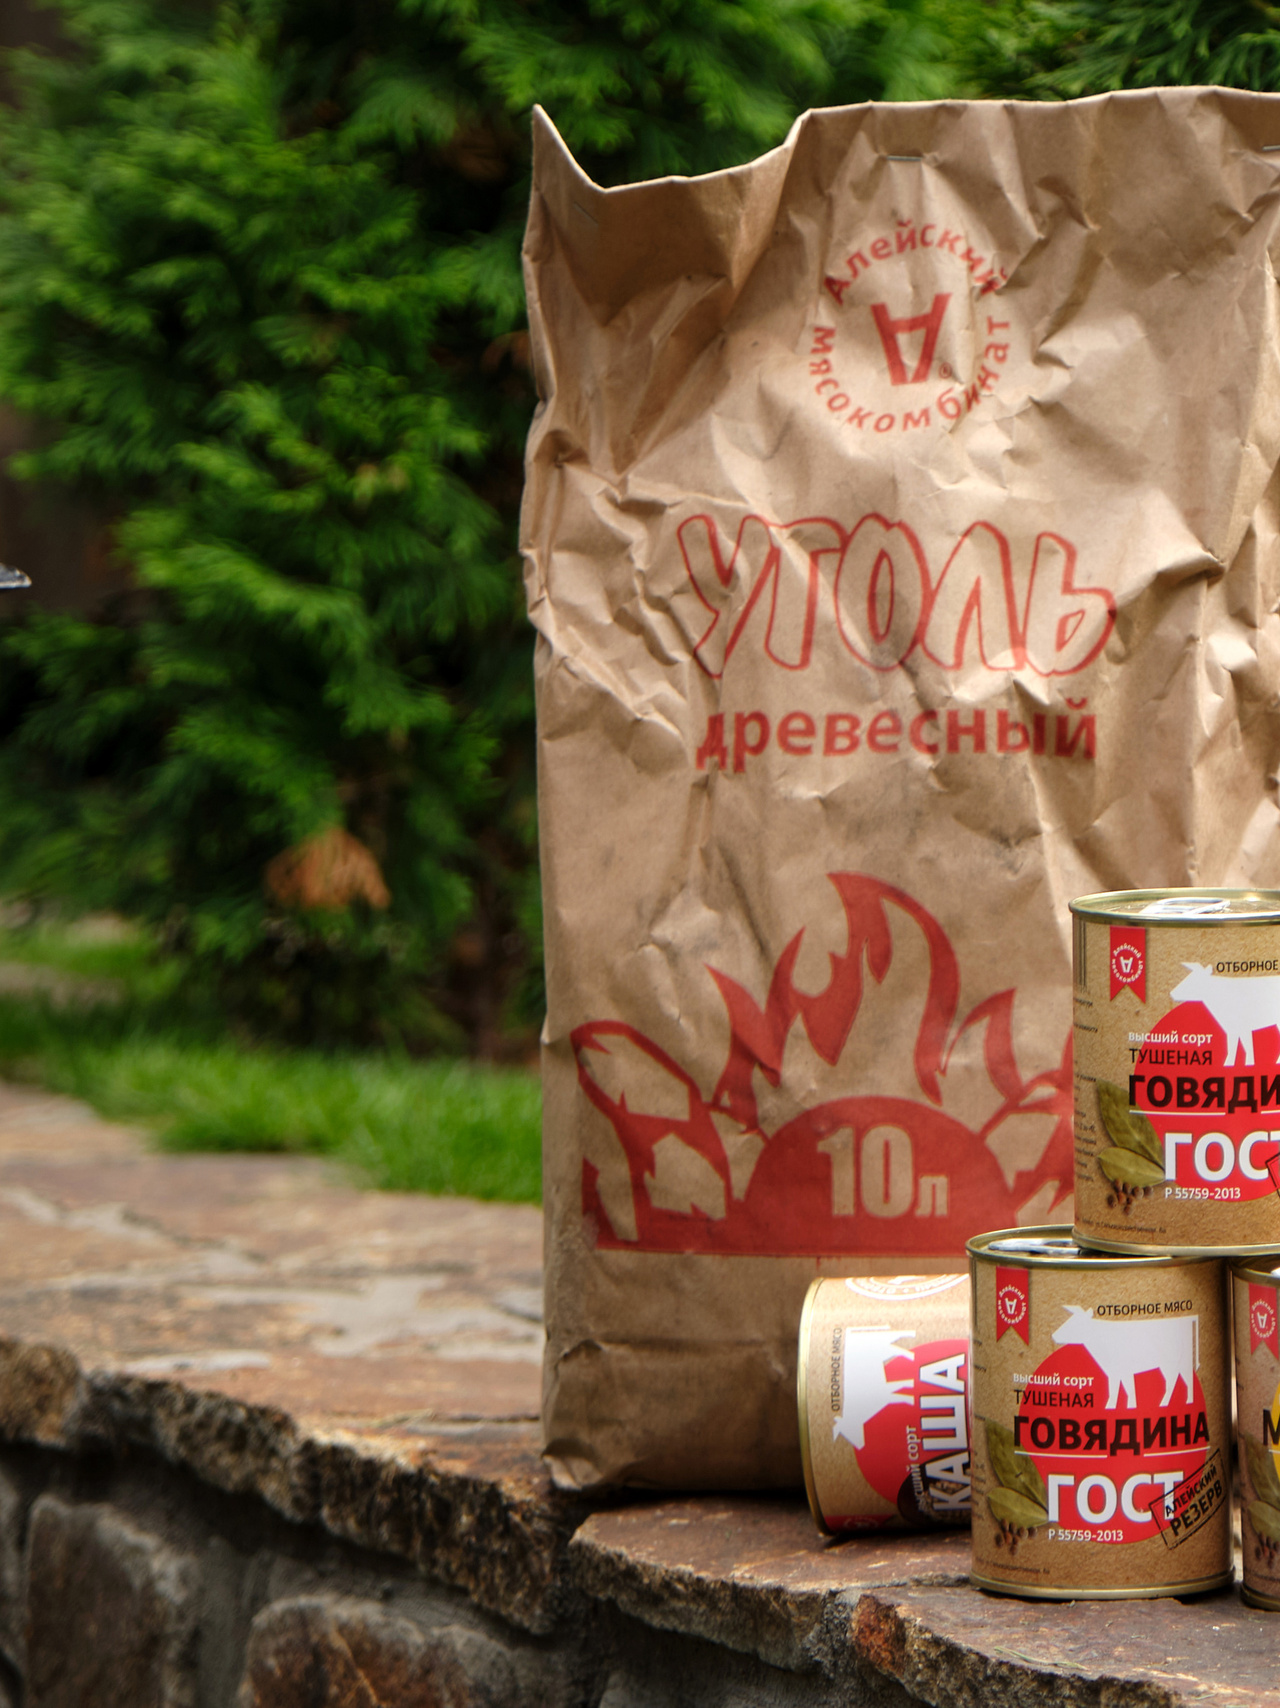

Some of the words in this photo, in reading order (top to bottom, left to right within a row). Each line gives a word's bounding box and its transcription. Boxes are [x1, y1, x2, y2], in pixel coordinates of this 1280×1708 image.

[824, 218, 1008, 306] Алейский
[809, 316, 1010, 434] мясокомбинат
[677, 512, 1117, 679] УГОЛЬ
[695, 698, 1098, 773] древесный
[1216, 959, 1279, 973] ОТБОРНОЕ
[1128, 1030, 1179, 1044] высший
[1181, 1033, 1213, 1046] сорт
[1128, 1048, 1213, 1066] ТУШЕНАЯ
[1164, 1187, 1173, 1199] Р
[1174, 1187, 1242, 1200] 55759-2013
[1097, 1302, 1161, 1316] ОТБОРНОЕ
[1163, 1299, 1193, 1313] МЯСО
[832, 1327, 842, 1354] МЯСО
[831, 1355, 840, 1412] ОТБОРНОЕ
[1013, 1372, 1061, 1386] высший
[1063, 1375, 1094, 1389] сорт
[1013, 1389, 1094, 1408] ТУШЕНАЯ
[906, 1425, 921, 1461] сорт
[919, 1353, 972, 1511] КАША
[1013, 1411, 1210, 1456] ГОВЯДИНА
[1047, 1471, 1184, 1524] ГОСТ
[1165, 1463, 1217, 1517] АЛЕЙСКИЙ
[1169, 1480, 1223, 1537] РЕЗЕРВ
[1048, 1529, 1056, 1541] Р
[1057, 1529, 1124, 1542] 55759-2013
